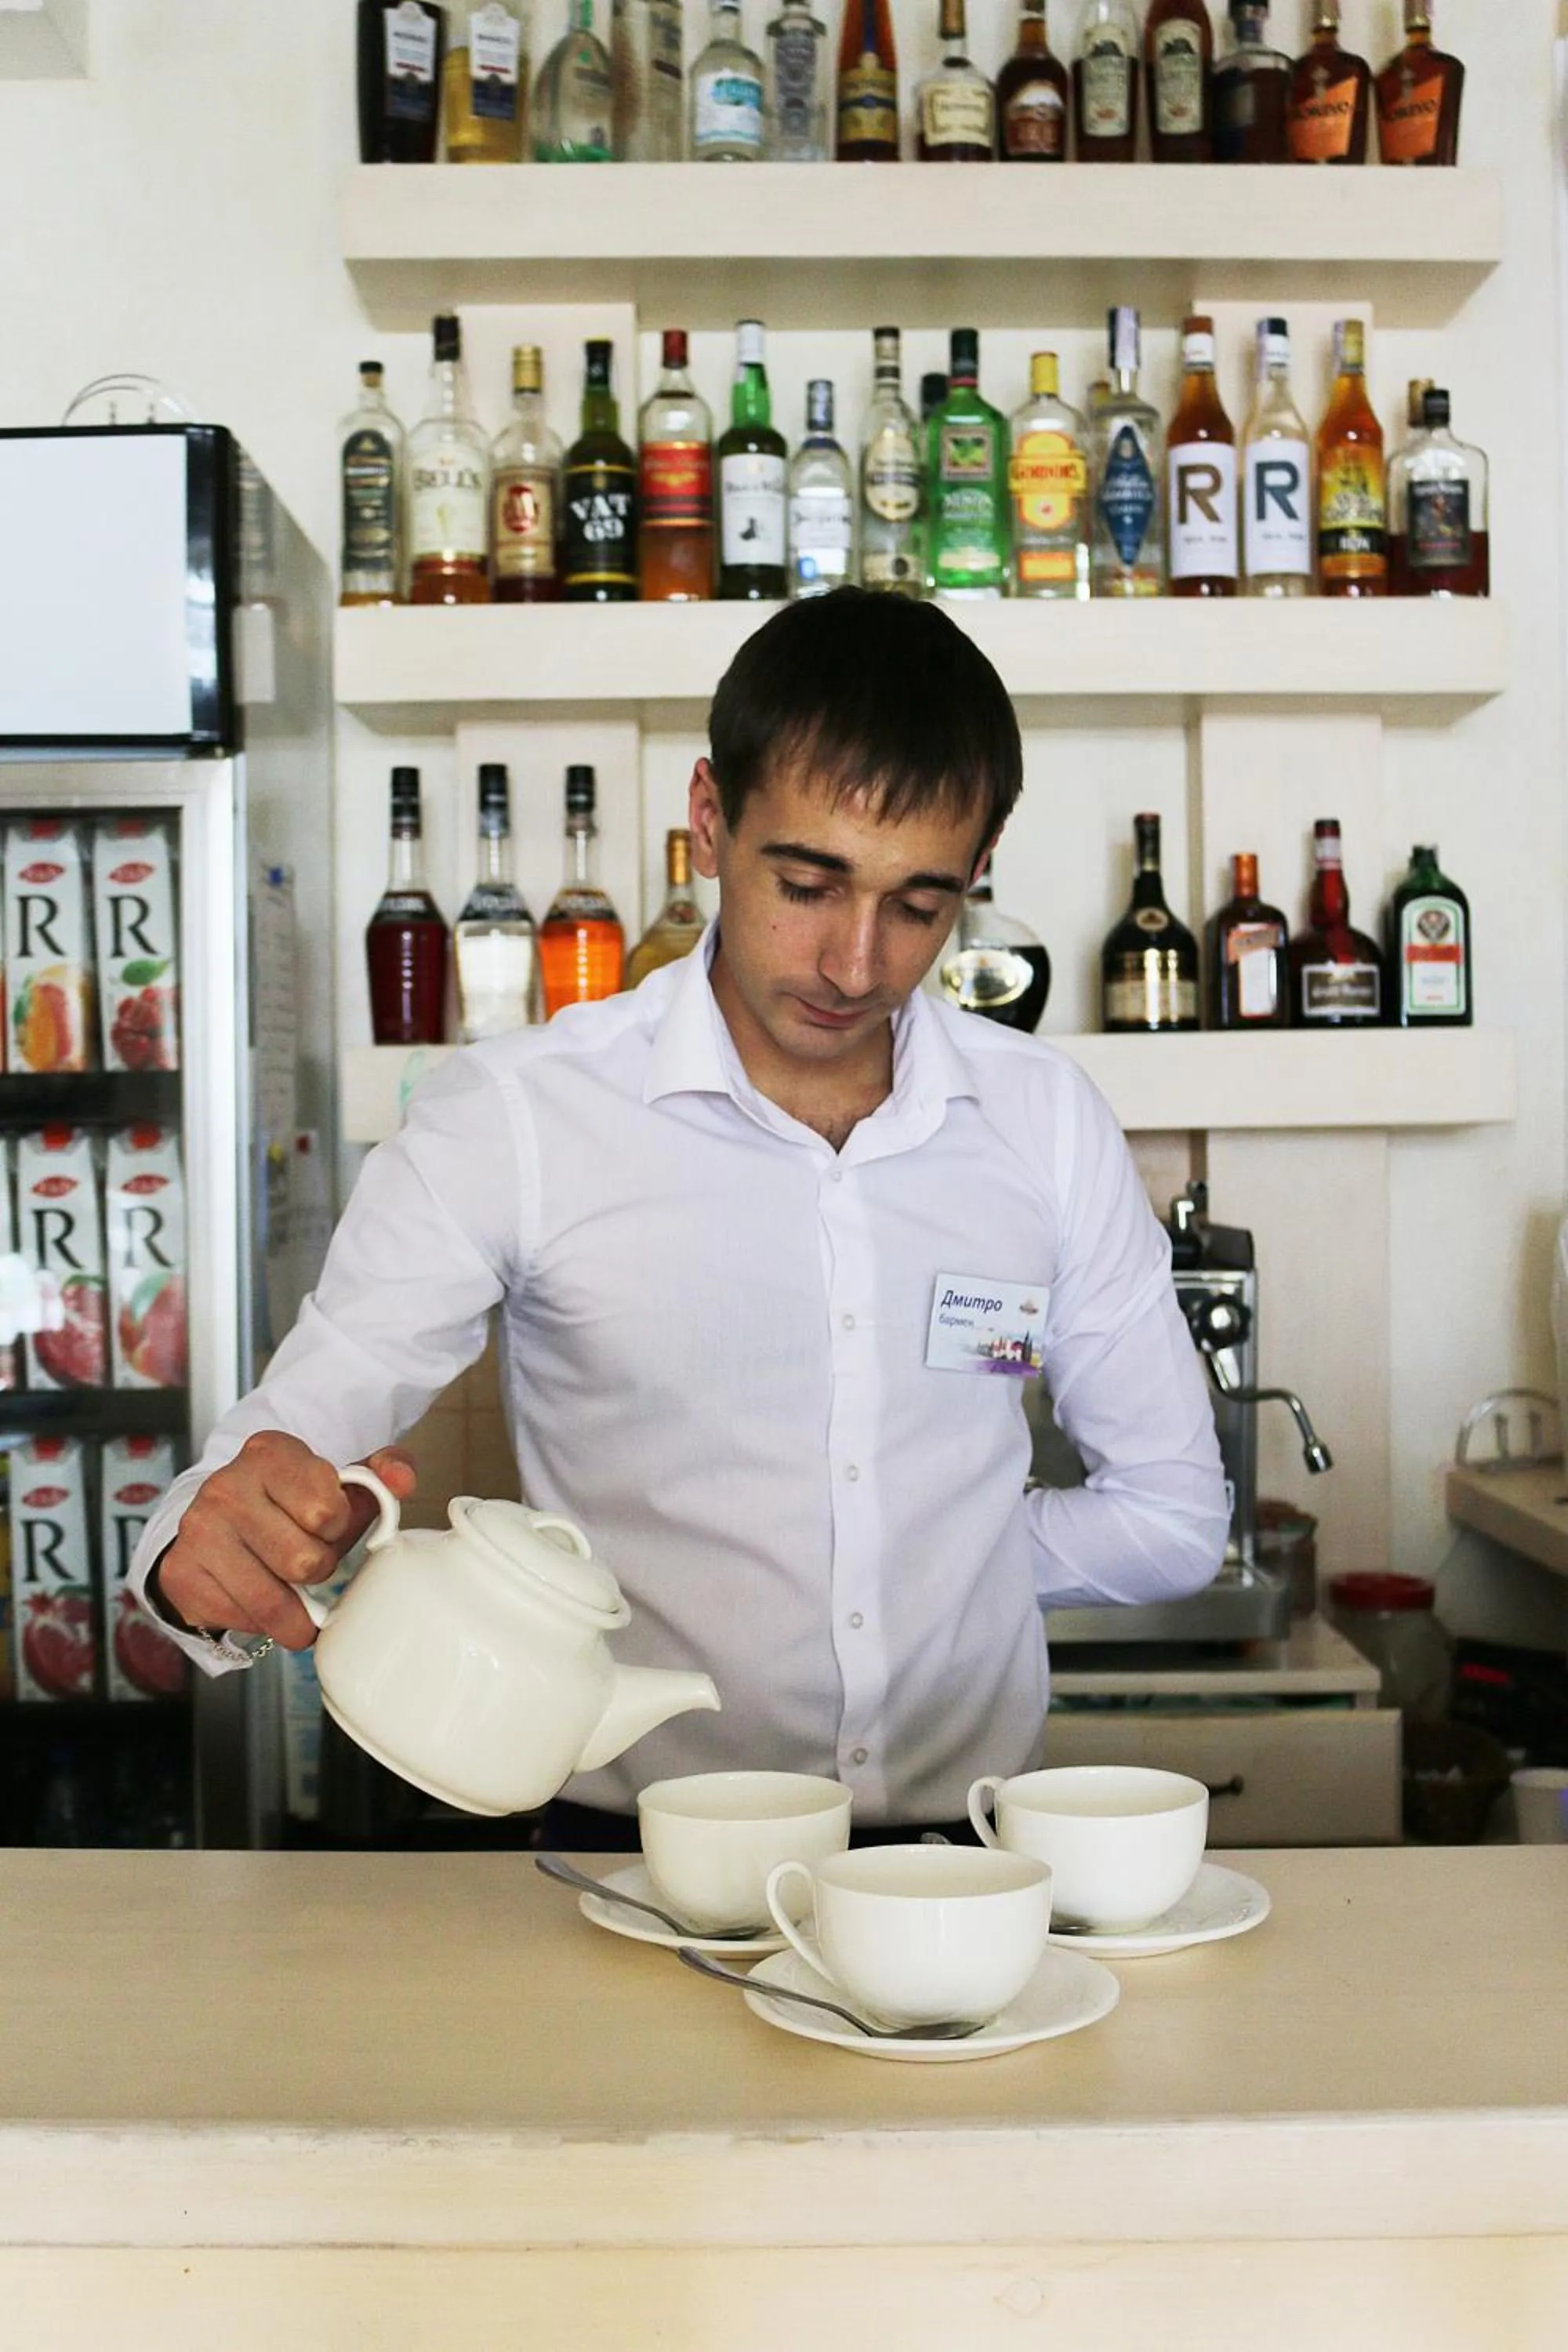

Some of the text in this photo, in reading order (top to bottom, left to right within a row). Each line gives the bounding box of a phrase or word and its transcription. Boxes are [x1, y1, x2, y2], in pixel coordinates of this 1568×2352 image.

[571, 492, 631, 521] VAT
[1178, 465, 1221, 524] R
[1256, 461, 1299, 521] R
[583, 517, 625, 543] 69
[16, 895, 65, 957] R
[107, 895, 158, 957] R
[32, 1208, 84, 1270] R
[122, 1207, 173, 1269] R
[941, 1290, 1003, 1313] Дмитро
[22, 1518, 74, 1582] R
